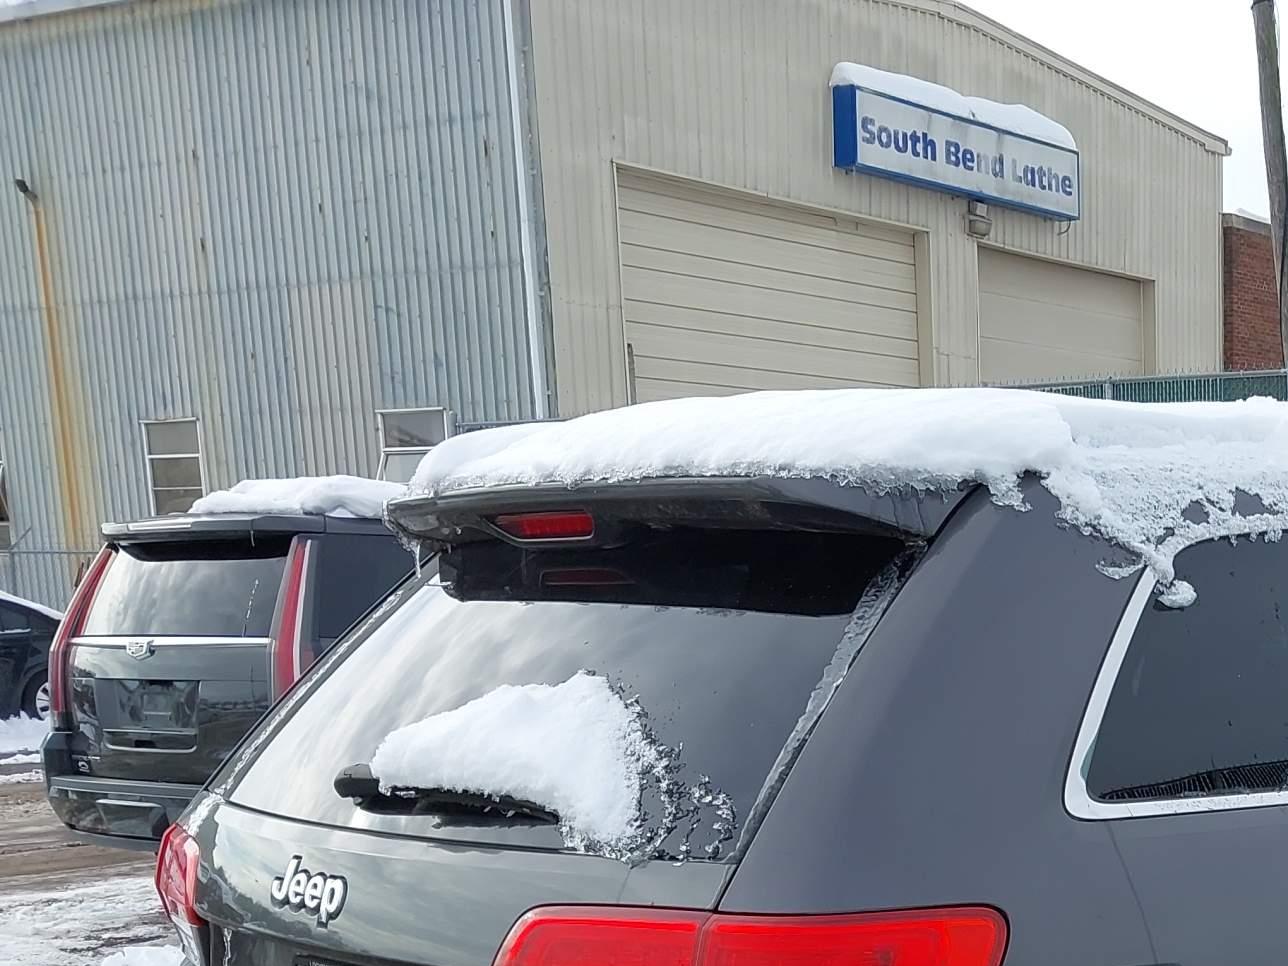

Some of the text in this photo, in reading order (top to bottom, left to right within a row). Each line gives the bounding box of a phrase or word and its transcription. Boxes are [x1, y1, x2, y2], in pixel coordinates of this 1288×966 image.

[860, 115, 1074, 197] South Bend Lathe
[271, 855, 348, 929] Jeep
